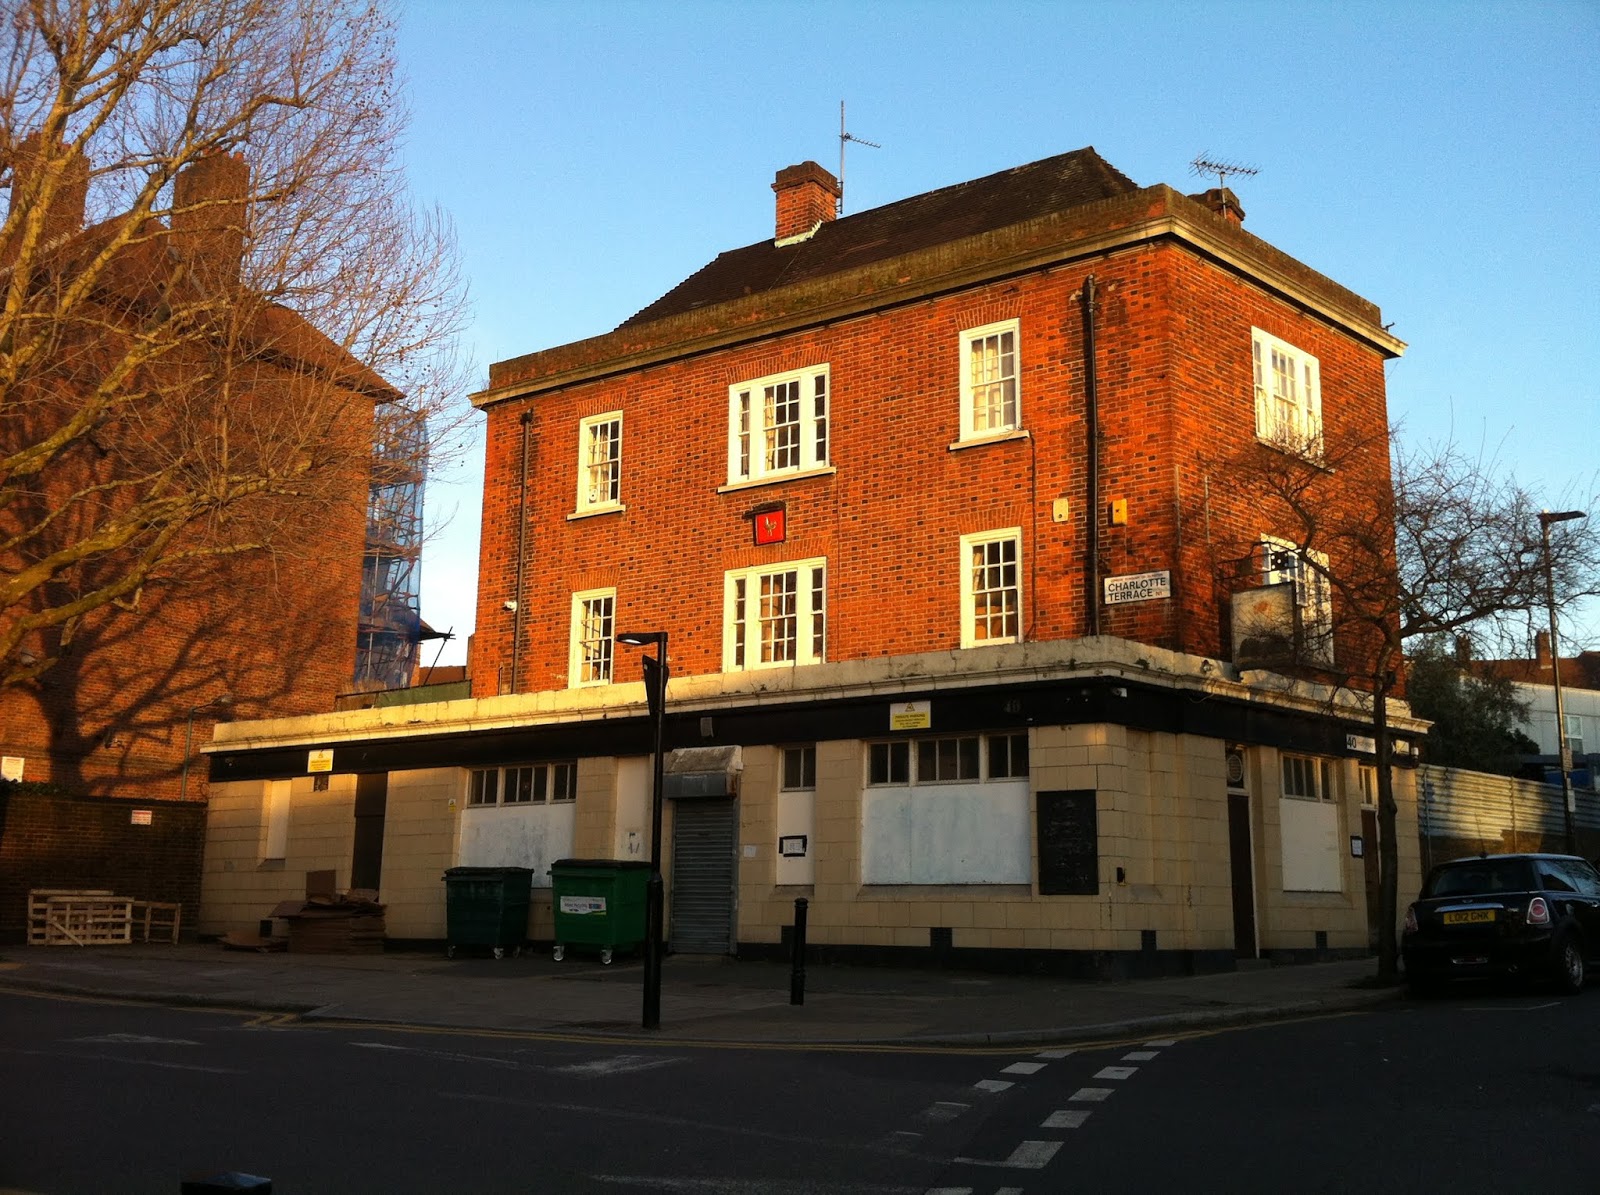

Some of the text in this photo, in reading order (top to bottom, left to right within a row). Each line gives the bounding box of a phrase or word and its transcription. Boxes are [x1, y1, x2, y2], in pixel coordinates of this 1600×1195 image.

[1108, 577, 1166, 592] CHARLOTTE
[1108, 589, 1153, 602] TERRACE
[1347, 736, 1357, 749] 40
